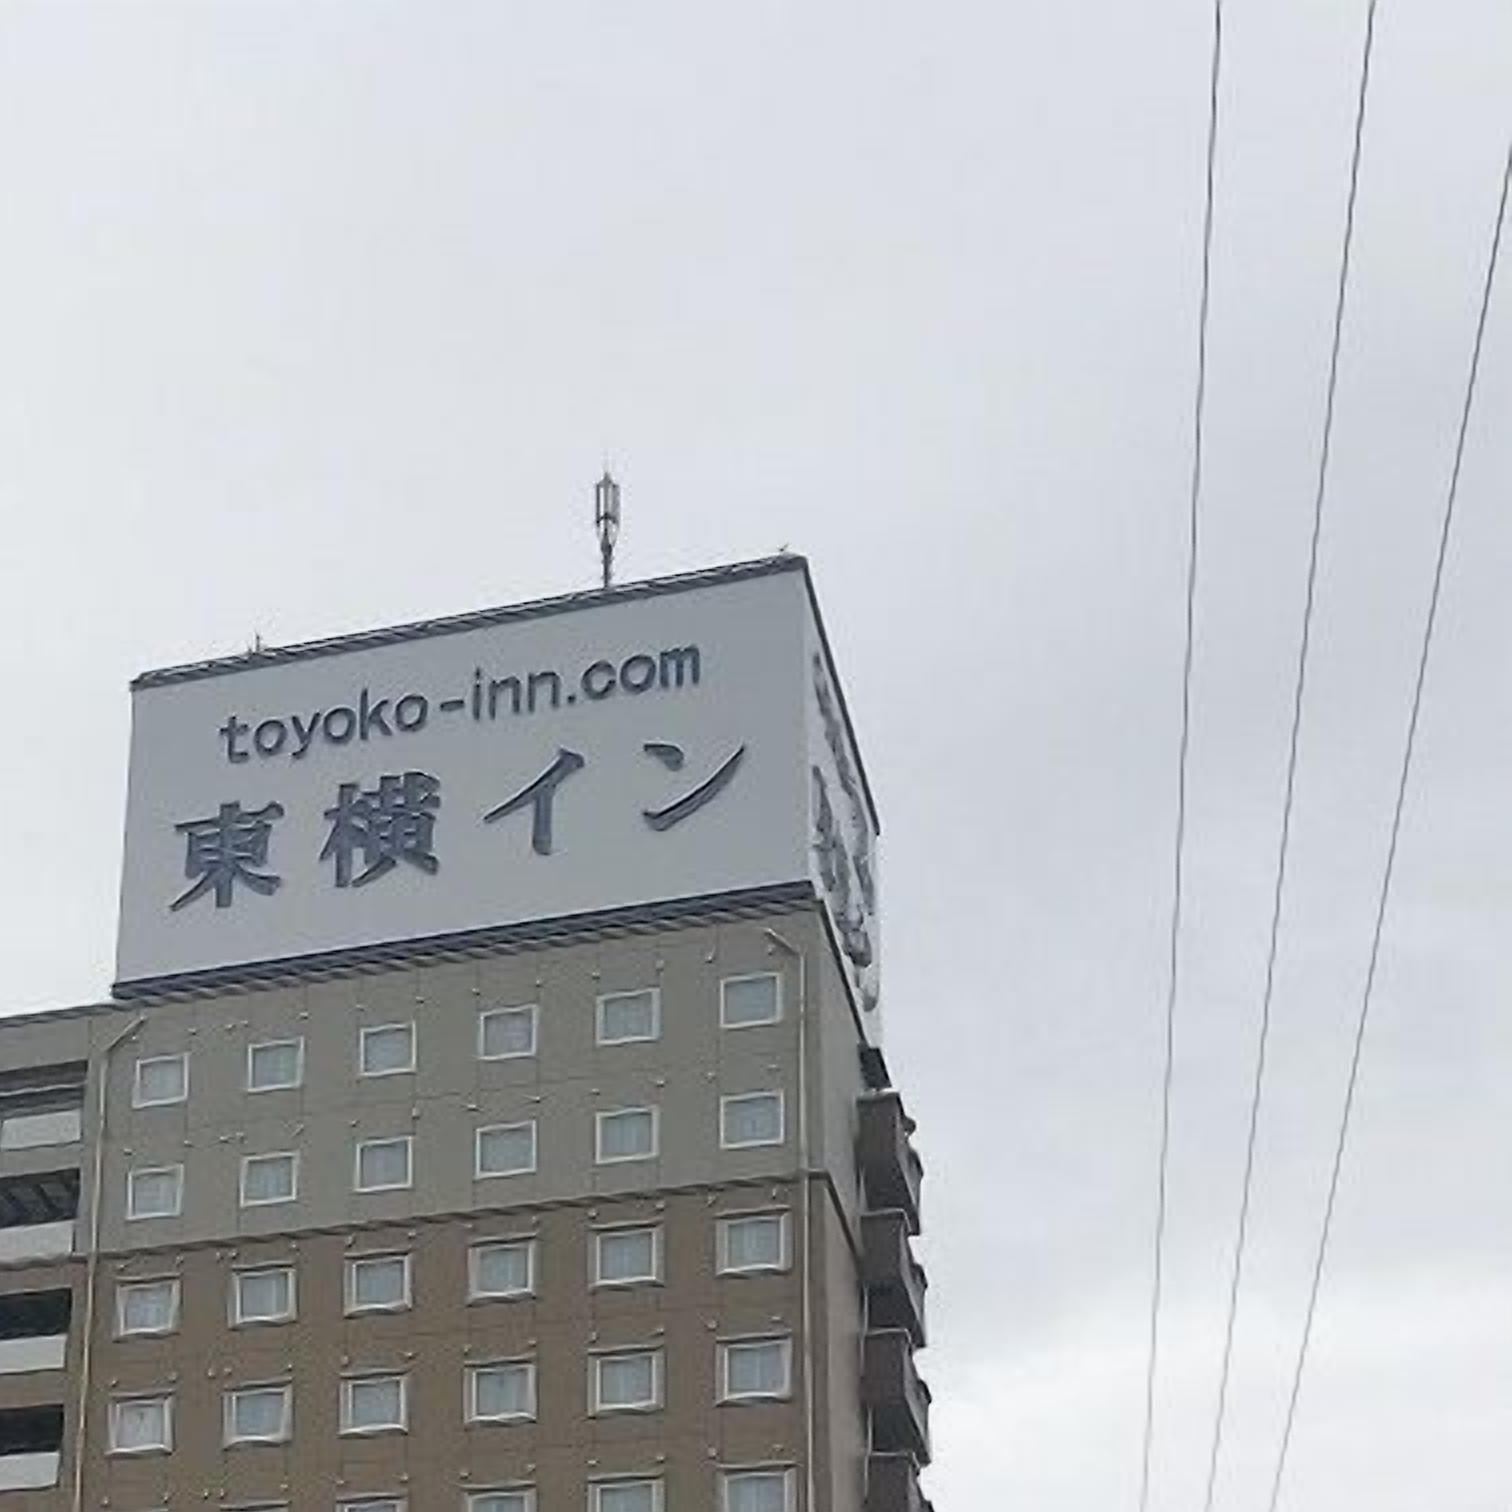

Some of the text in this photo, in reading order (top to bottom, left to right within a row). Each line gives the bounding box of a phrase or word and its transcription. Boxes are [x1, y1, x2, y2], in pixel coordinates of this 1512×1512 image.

[219, 642, 701, 764] toyoko-inn.com
[169, 743, 746, 912] 東横イン
